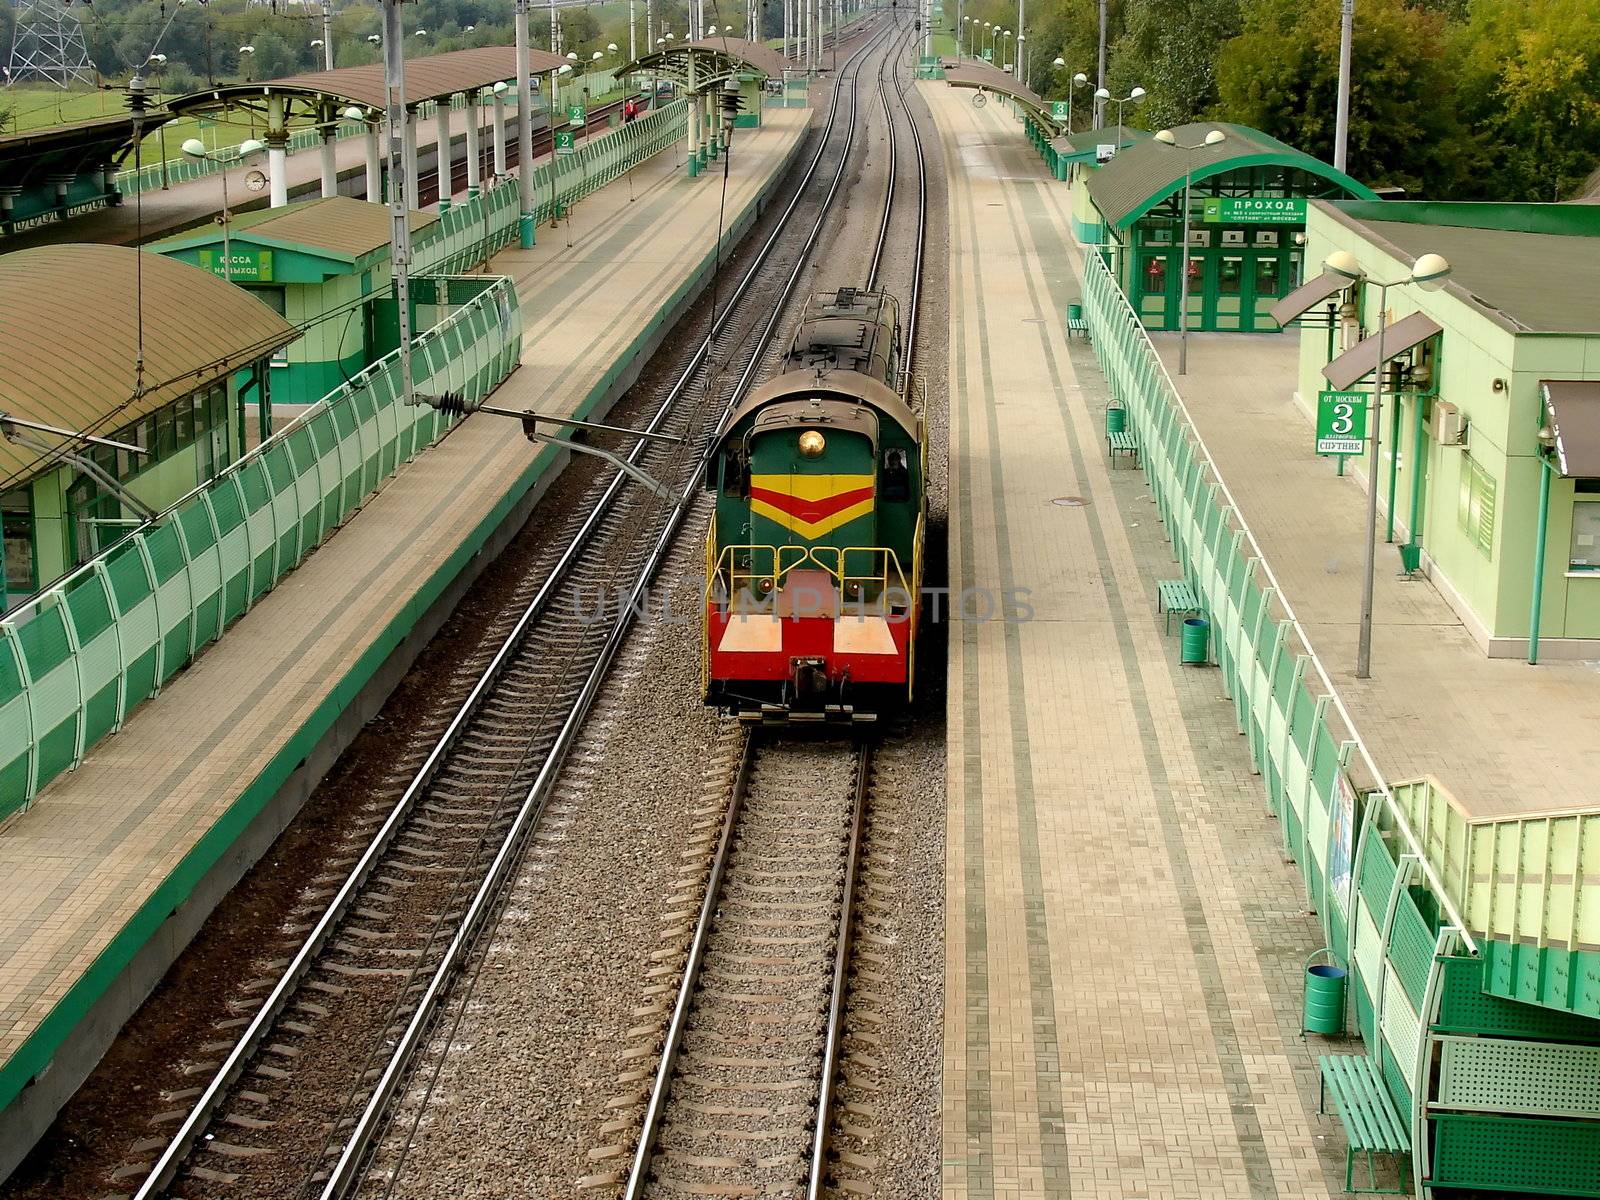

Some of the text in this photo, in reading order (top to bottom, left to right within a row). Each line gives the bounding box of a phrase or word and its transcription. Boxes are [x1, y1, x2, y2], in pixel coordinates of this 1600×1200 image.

[573, 109, 580, 119] 2
[1056, 104, 1064, 114] 3
[561, 135, 569, 147] 2
[1234, 201, 1294, 210] ПРОХОД
[228, 267, 258, 275] ЫХОД
[1323, 395, 1362, 403] ОТ МОСКВЫ
[1331, 403, 1353, 434] 3
[1320, 441, 1361, 451] СПУТНИК
